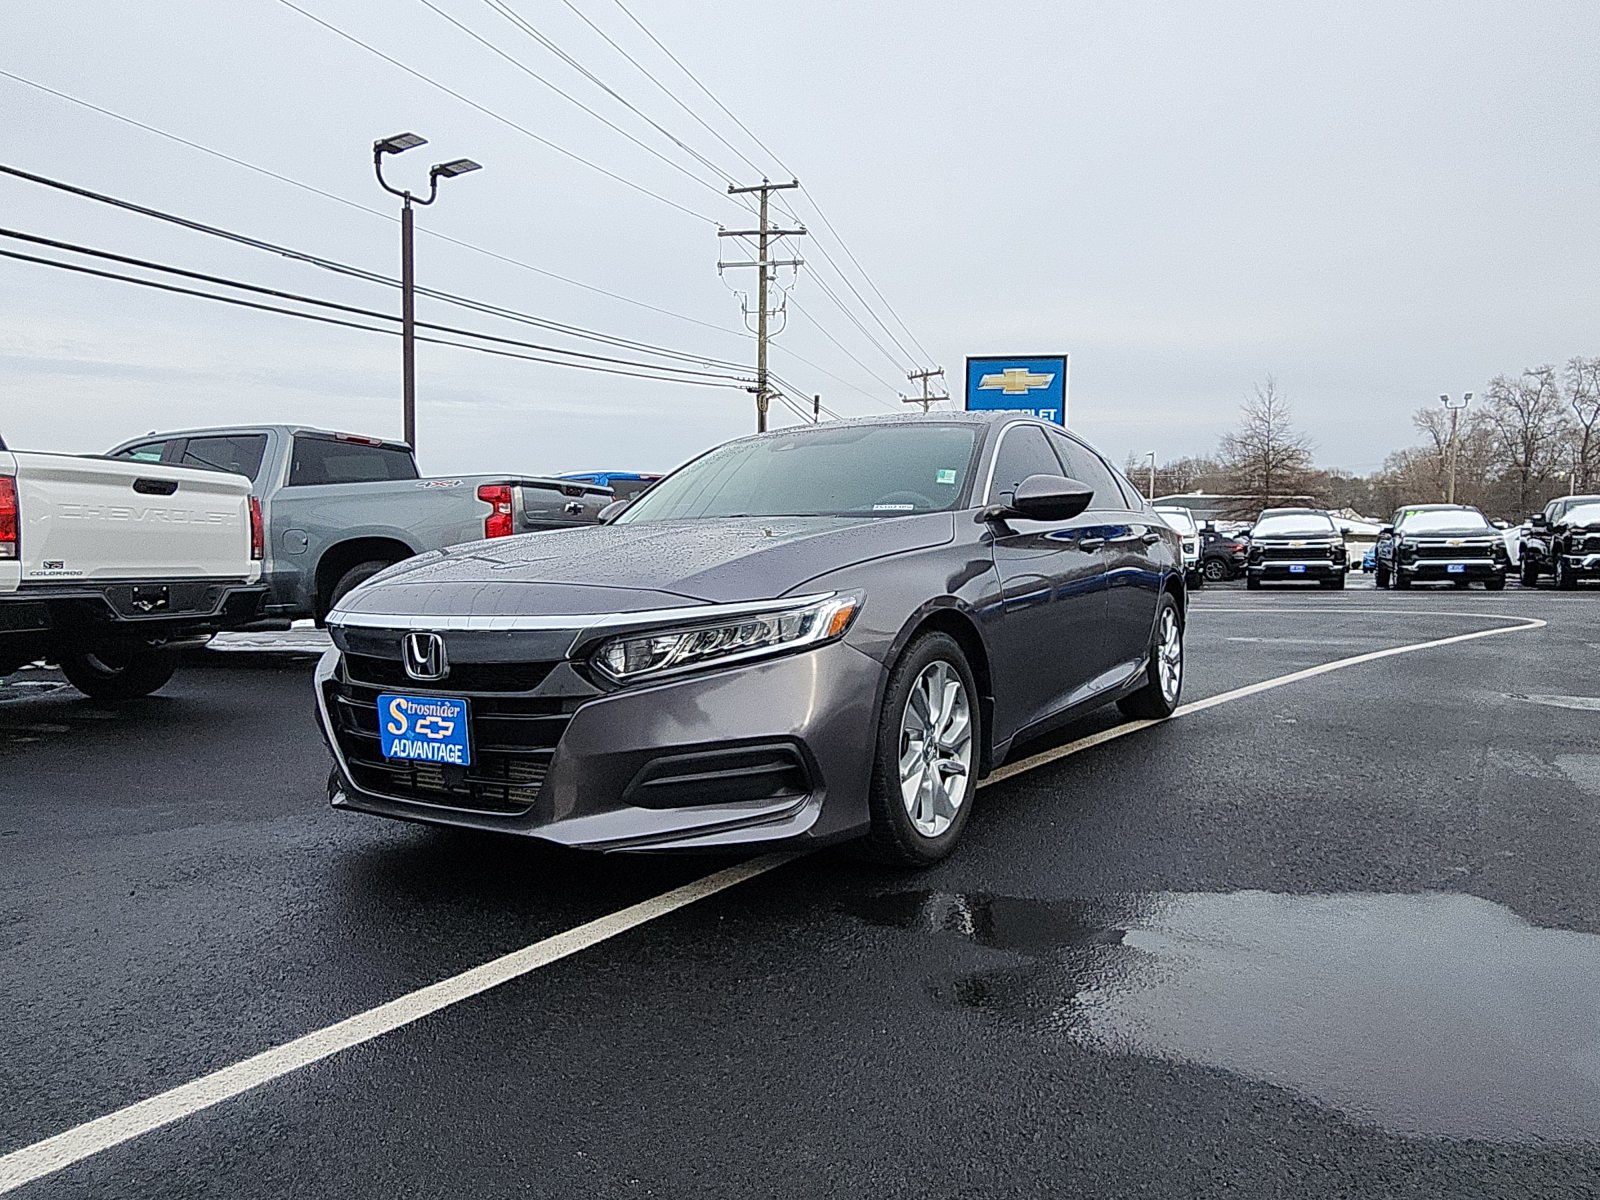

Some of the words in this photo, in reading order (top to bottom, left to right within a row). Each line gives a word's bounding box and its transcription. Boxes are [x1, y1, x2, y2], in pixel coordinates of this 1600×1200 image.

[58, 504, 237, 526] CHEVROLET
[387, 698, 460, 735] Strosnider
[391, 739, 463, 763] ADVANTAGE
